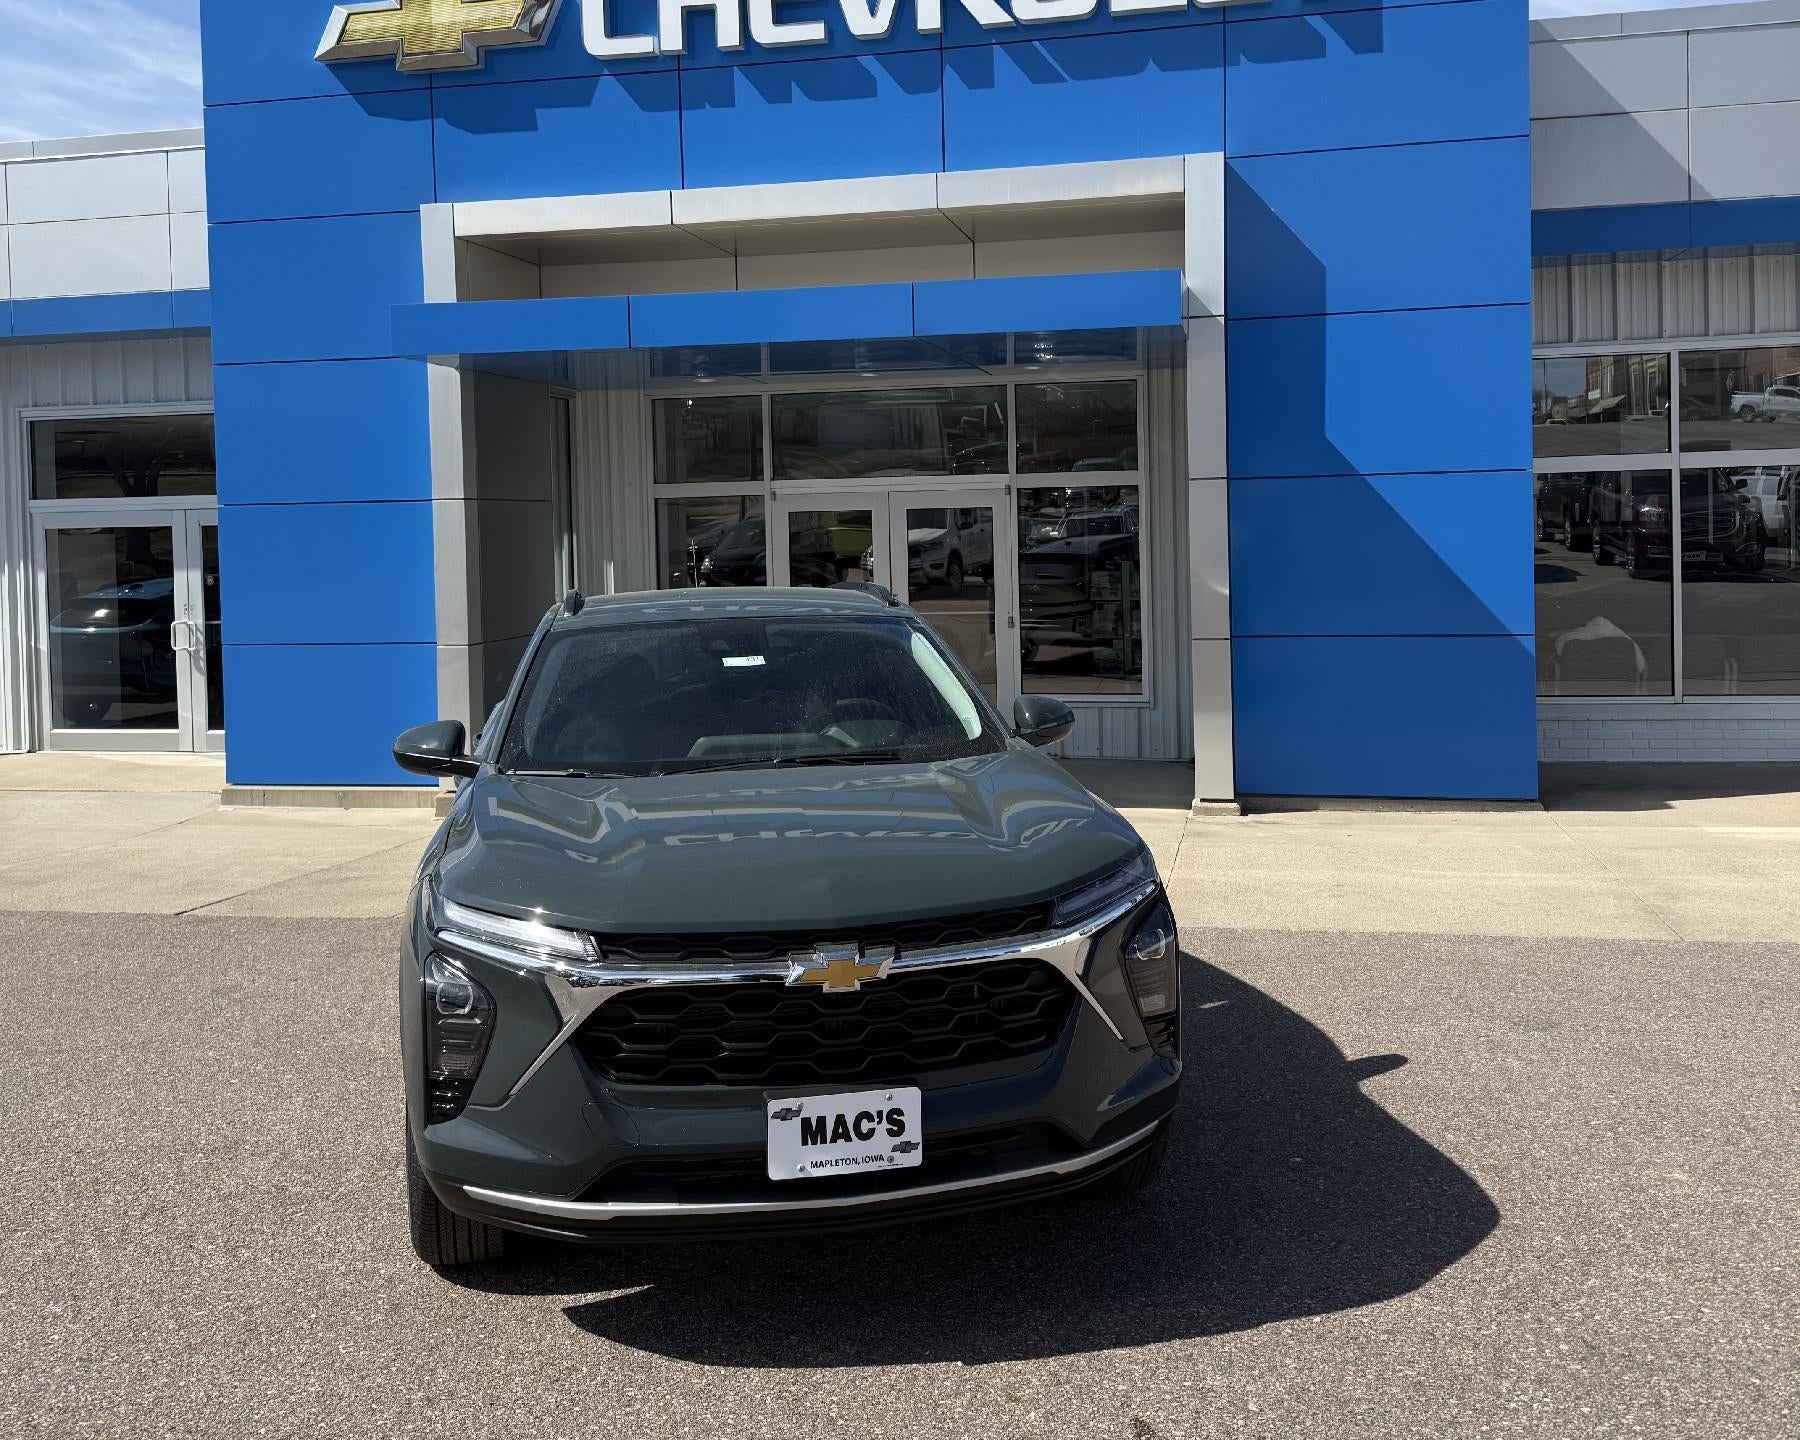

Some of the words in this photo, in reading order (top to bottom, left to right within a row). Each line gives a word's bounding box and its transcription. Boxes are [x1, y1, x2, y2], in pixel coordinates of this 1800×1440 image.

[801, 1108, 905, 1146] MAC'S
[810, 1157, 860, 1169] MAPLETON,
[861, 1154, 885, 1165] IOWA
